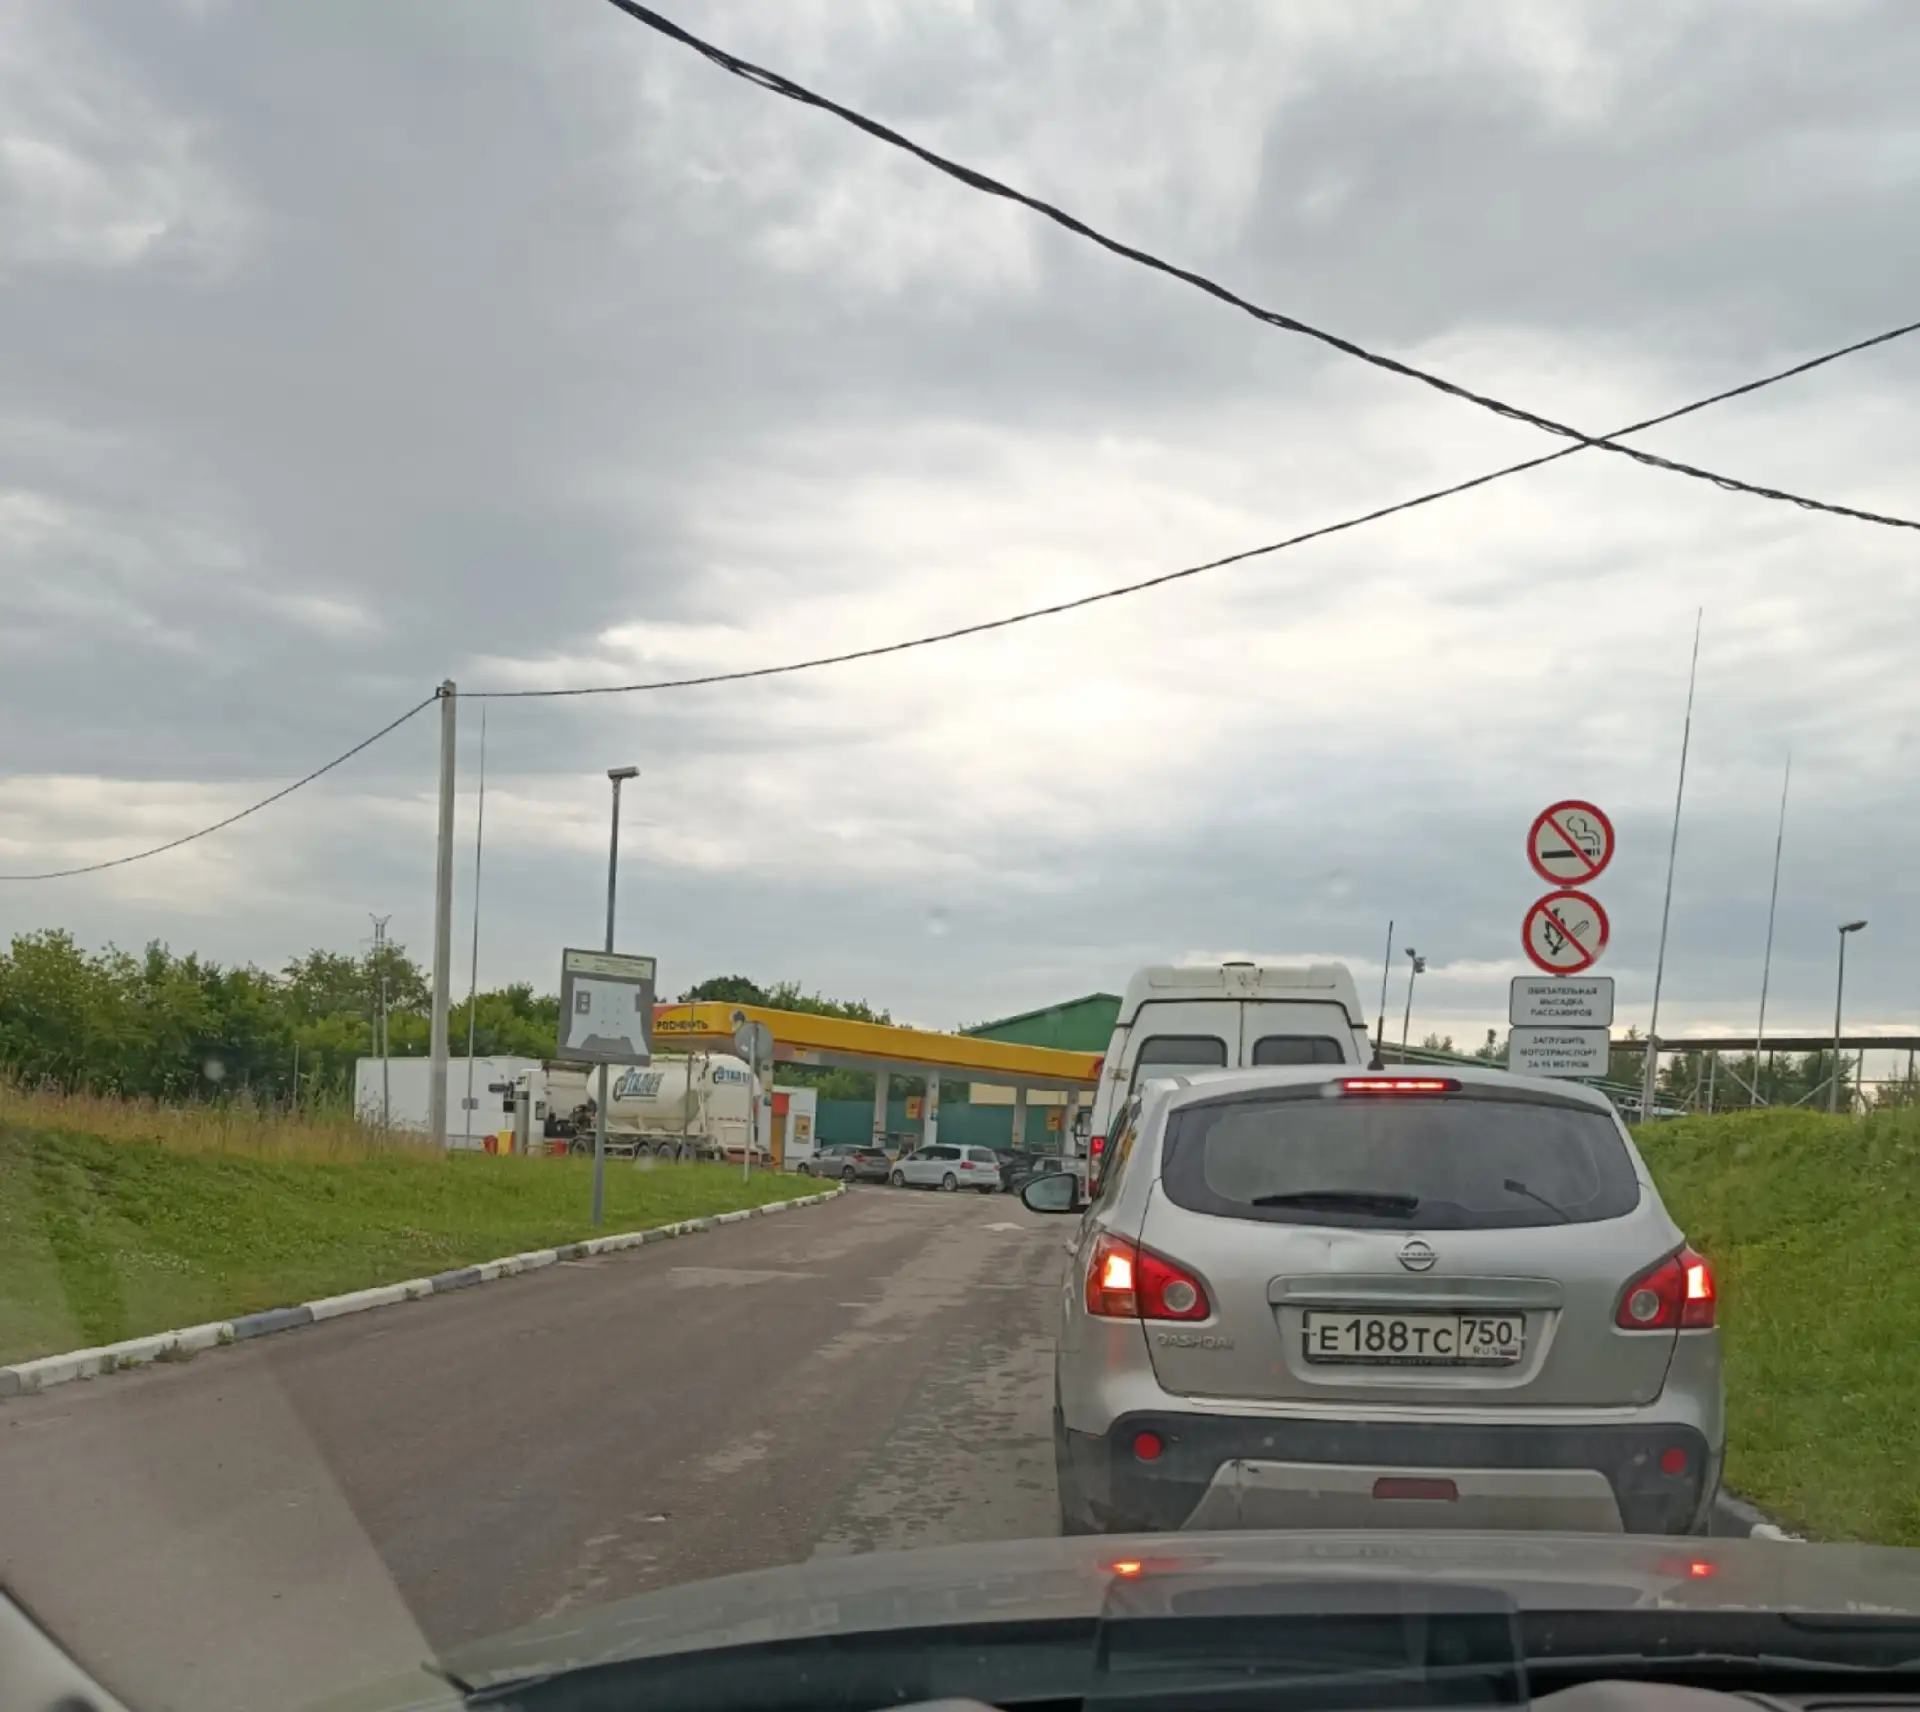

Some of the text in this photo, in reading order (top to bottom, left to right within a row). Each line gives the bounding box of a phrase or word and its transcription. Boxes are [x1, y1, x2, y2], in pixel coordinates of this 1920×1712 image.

[1527, 987, 1597, 996] ОБЯЗАТЕЛЬНАЯ
[1539, 998, 1584, 1006] ВЫСАДКА
[1530, 1008, 1593, 1017] ПАССАЖИРОВ
[1532, 1036, 1586, 1045] ЗАГЛУШИТЬ
[1519, 1048, 1597, 1057] МОТОТРАНСПОРТ
[1553, 1060, 1589, 1069] МЕТРОВ
[1461, 1320, 1512, 1345] 750
[1473, 1346, 1499, 1355] RUS
